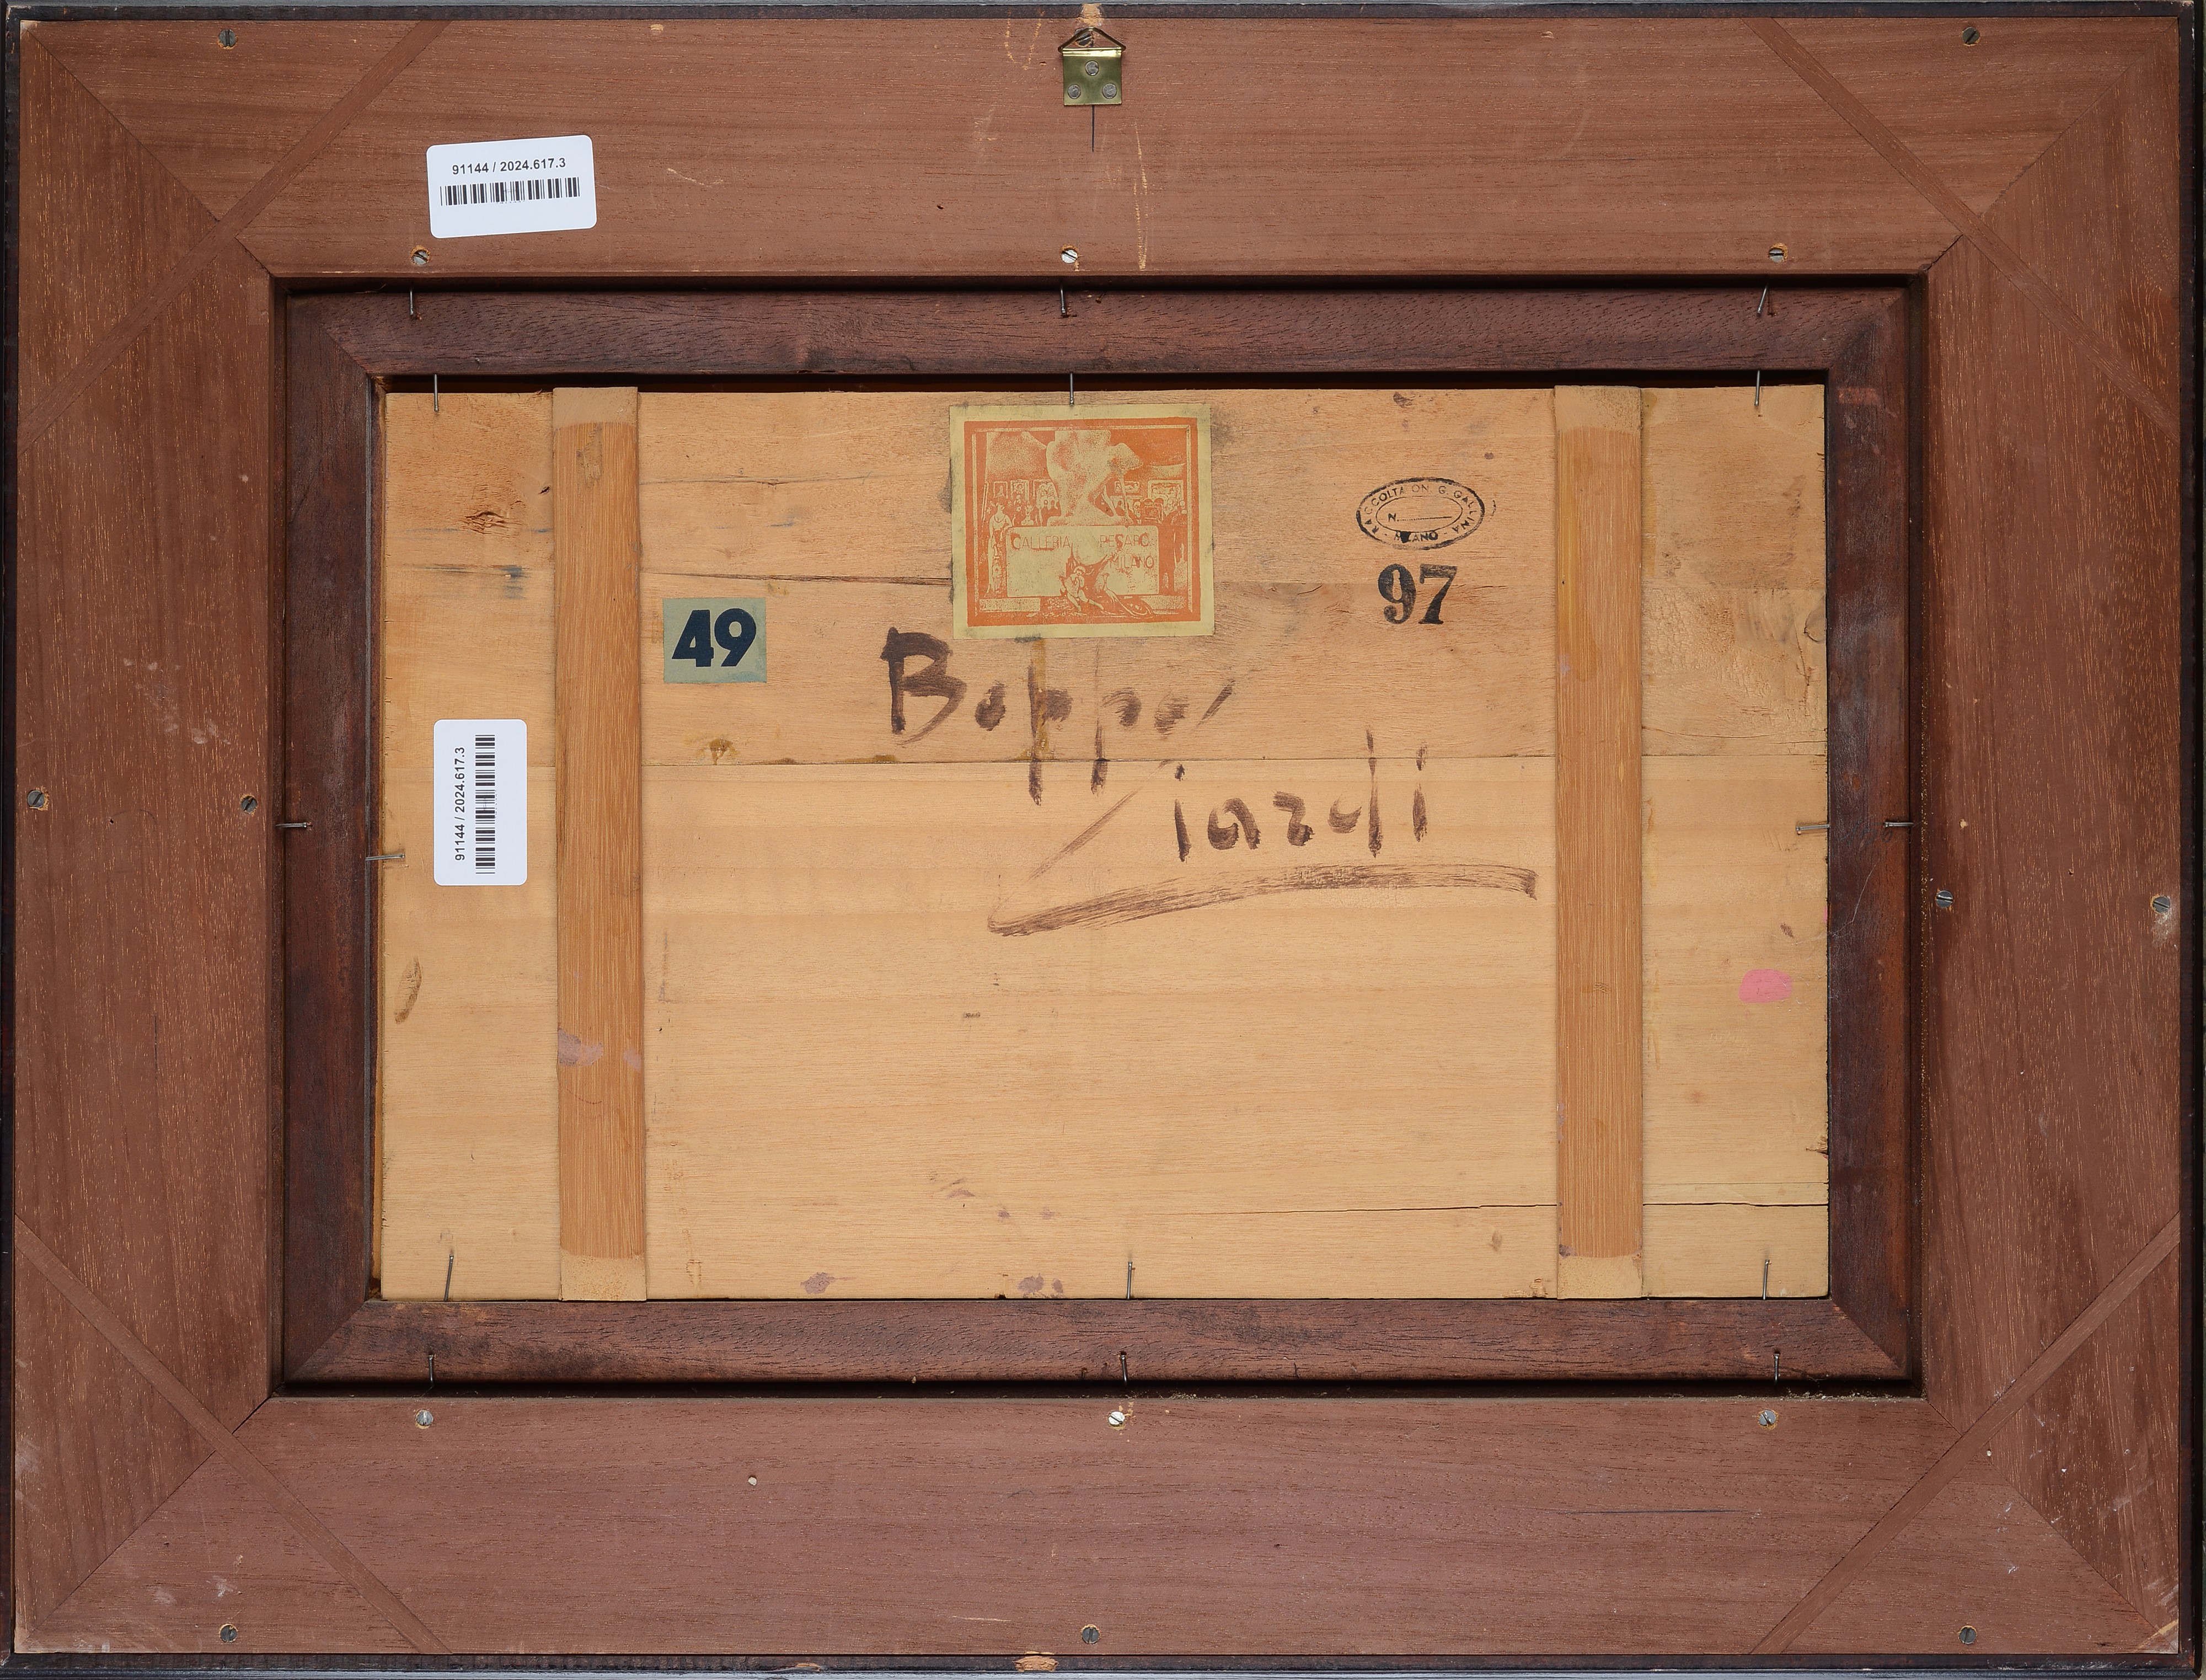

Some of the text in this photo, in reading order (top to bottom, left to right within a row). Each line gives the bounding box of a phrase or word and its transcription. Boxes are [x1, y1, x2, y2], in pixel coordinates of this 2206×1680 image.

[452, 157, 566, 175] 91144 / 2024.617.3
[1010, 532, 1070, 552] GALLERIA
[1110, 555, 1154, 569] MILANO
[1378, 563, 1458, 624] 97
[671, 608, 757, 667] 49
[454, 747, 465, 813] 2024.617.3
[454, 823, 465, 860] 91144
